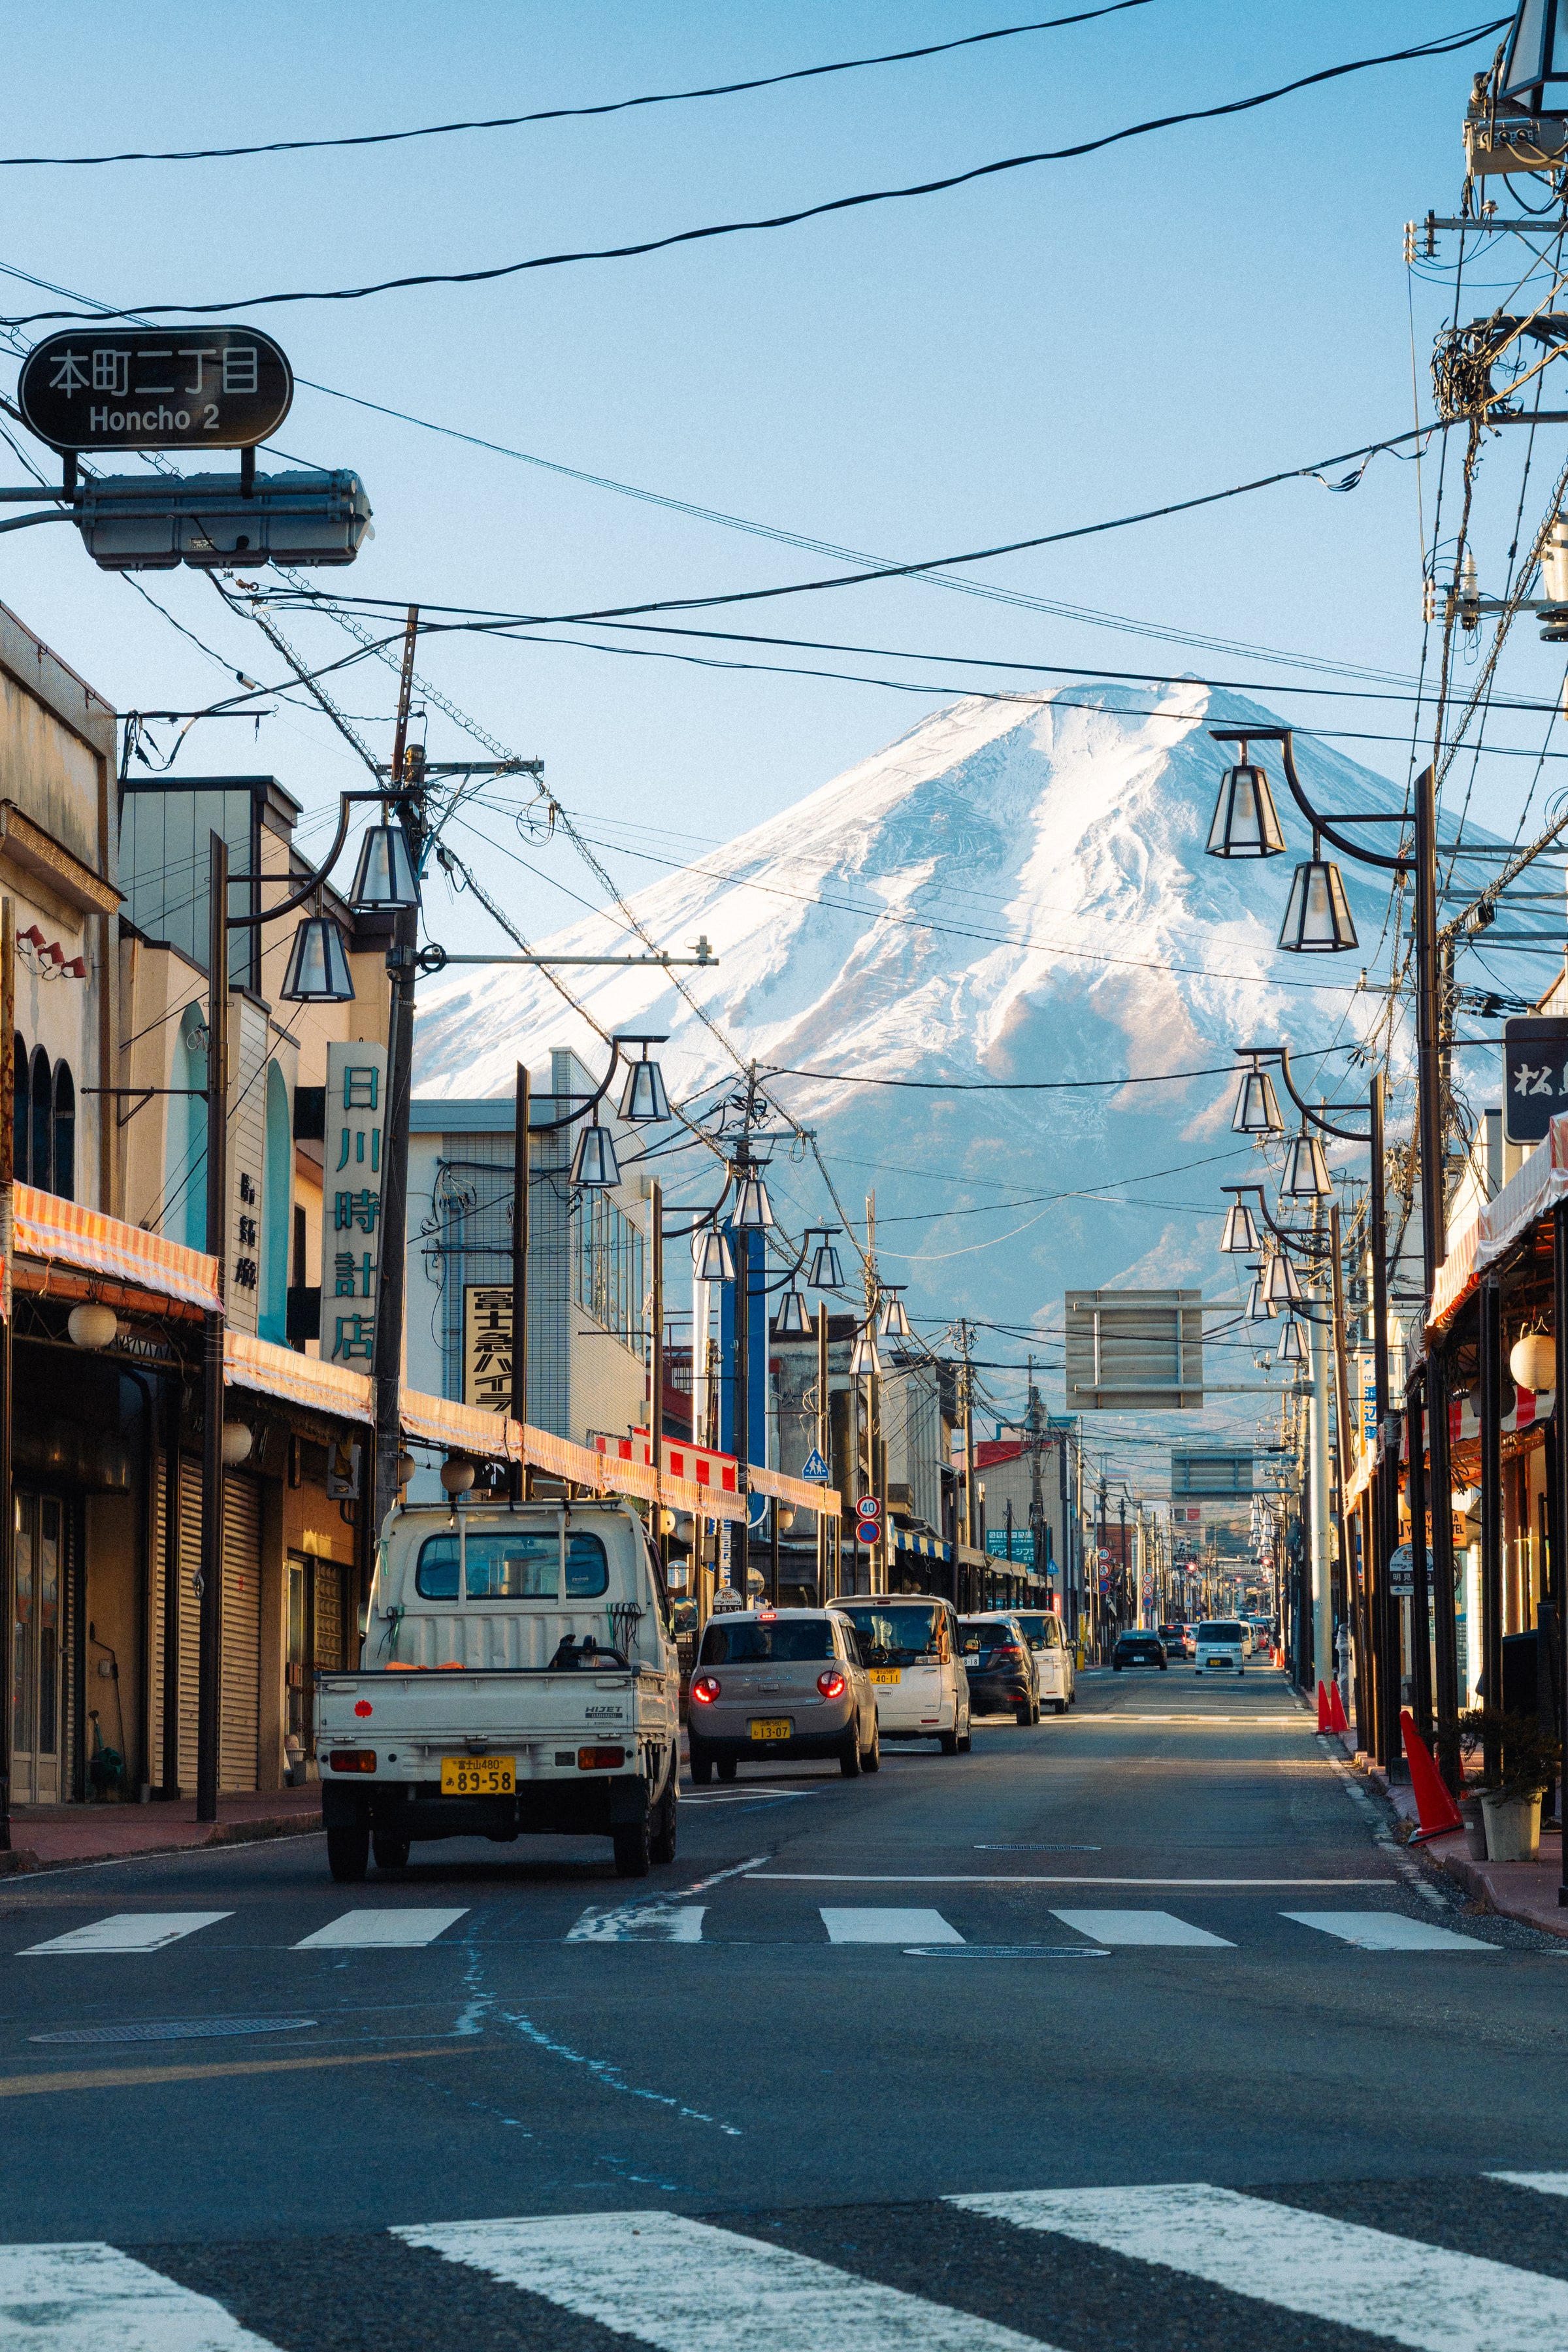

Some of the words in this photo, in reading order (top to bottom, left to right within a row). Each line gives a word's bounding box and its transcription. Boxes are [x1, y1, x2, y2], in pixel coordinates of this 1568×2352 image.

[49, 347, 257, 399] 本町二丁目
[90, 405, 190, 431] Honcho
[203, 404, 220, 429] 2
[332, 1065, 380, 1363] 日川時計店
[473, 1290, 513, 1412] 富士急ハイラ
[862, 1502, 875, 1513] 40
[761, 1727, 787, 1738] 13-07
[459, 1760, 499, 1770] 富士山480
[446, 1777, 454, 1786] あ
[458, 1772, 511, 1791] 89-58
